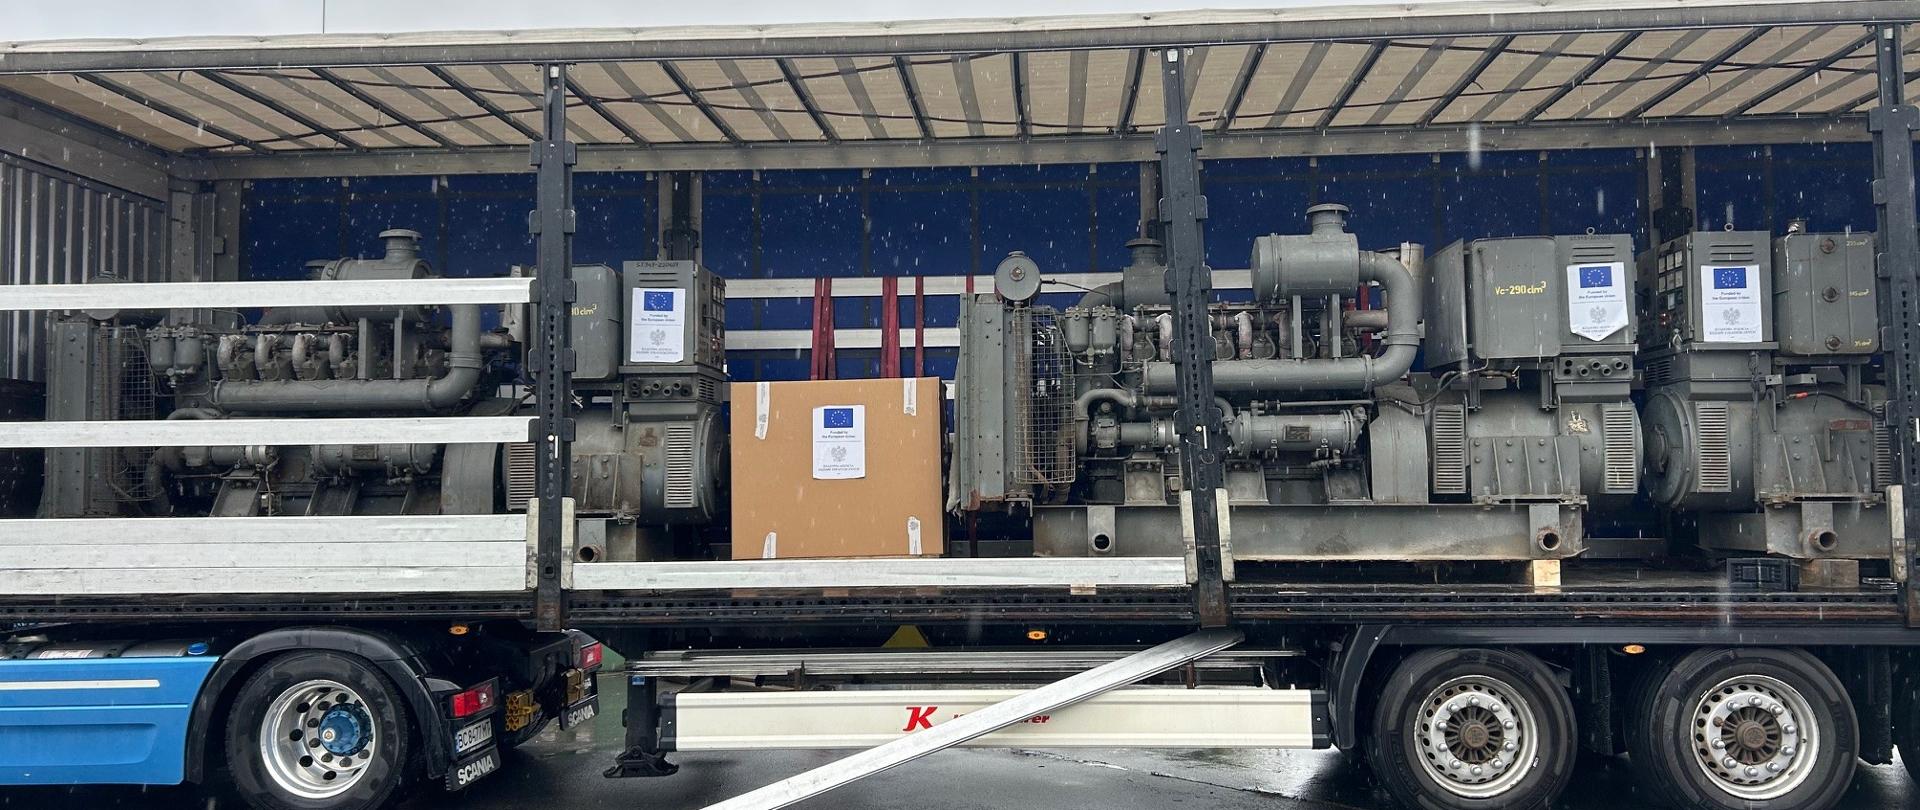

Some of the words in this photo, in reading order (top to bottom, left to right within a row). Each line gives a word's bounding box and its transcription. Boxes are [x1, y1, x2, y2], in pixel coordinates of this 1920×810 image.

[567, 704, 595, 727] SCANIA
[903, 706, 938, 731] K
[457, 755, 495, 785] SCANIA
